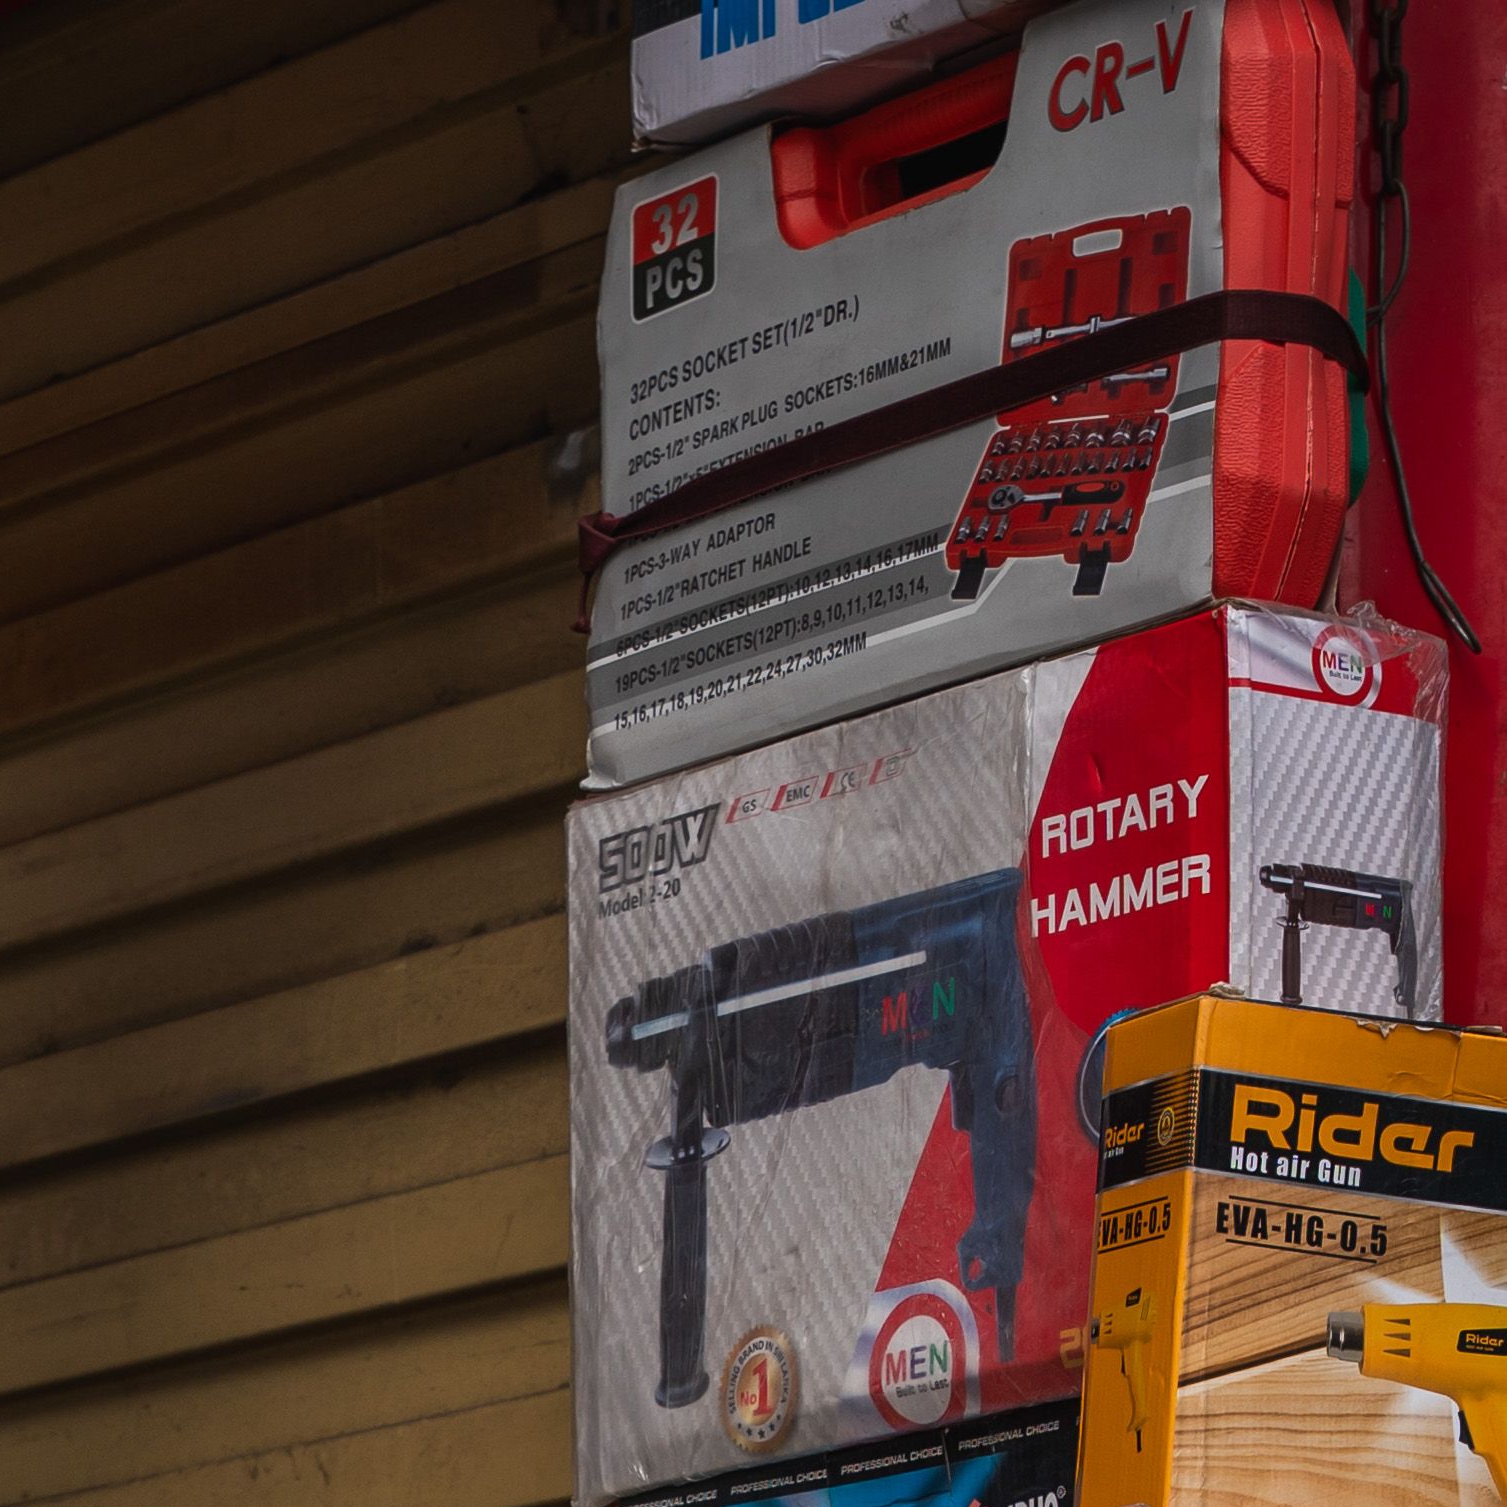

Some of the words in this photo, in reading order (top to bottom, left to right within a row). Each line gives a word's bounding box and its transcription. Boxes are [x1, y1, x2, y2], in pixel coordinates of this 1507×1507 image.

[1047, 10, 1192, 132] CR-V
[652, 194, 700, 256] 32
[646, 248, 703, 308] PCS
[630, 363, 678, 404] 32PCS
[682, 337, 748, 386] SOCKET
[629, 391, 721, 440] CONTENTS:
[692, 415, 738, 450] SPARK
[742, 401, 778, 430] PLUG
[624, 538, 702, 584] 1PCS-3-WAY
[706, 513, 775, 551] ADAPTOR
[752, 536, 812, 572] HANDLE
[1322, 650, 1363, 673] MEN
[786, 784, 811, 802] EMC
[1041, 775, 1210, 859] ROTARY
[599, 802, 721, 894] 500W
[598, 894, 642, 919] Model
[1031, 853, 1212, 939] HAMMER
[1104, 1120, 1146, 1148] Rider
[1229, 1083, 1475, 1173] Rider
[1230, 1146, 1268, 1173] Hot
[1276, 1152, 1311, 1179] air
[1317, 1158, 1362, 1188] Gun
[1216, 1202, 1388, 1257] EVA-HG-0.5
[884, 1340, 949, 1386] MEN
[1465, 1332, 1505, 1349] Rider
[686, 1489, 718, 1506] CHOICE
[730, 1476, 795, 1496] PROFESSIONAL
[796, 1469, 829, 1487] CHOICE
[841, 1455, 908, 1476] PROFESSIONAL
[909, 1446, 943, 1464] CHOICE
[958, 1429, 1024, 1451] PROFESSIONAL
[1024, 1421, 1060, 1440] CHOICE
